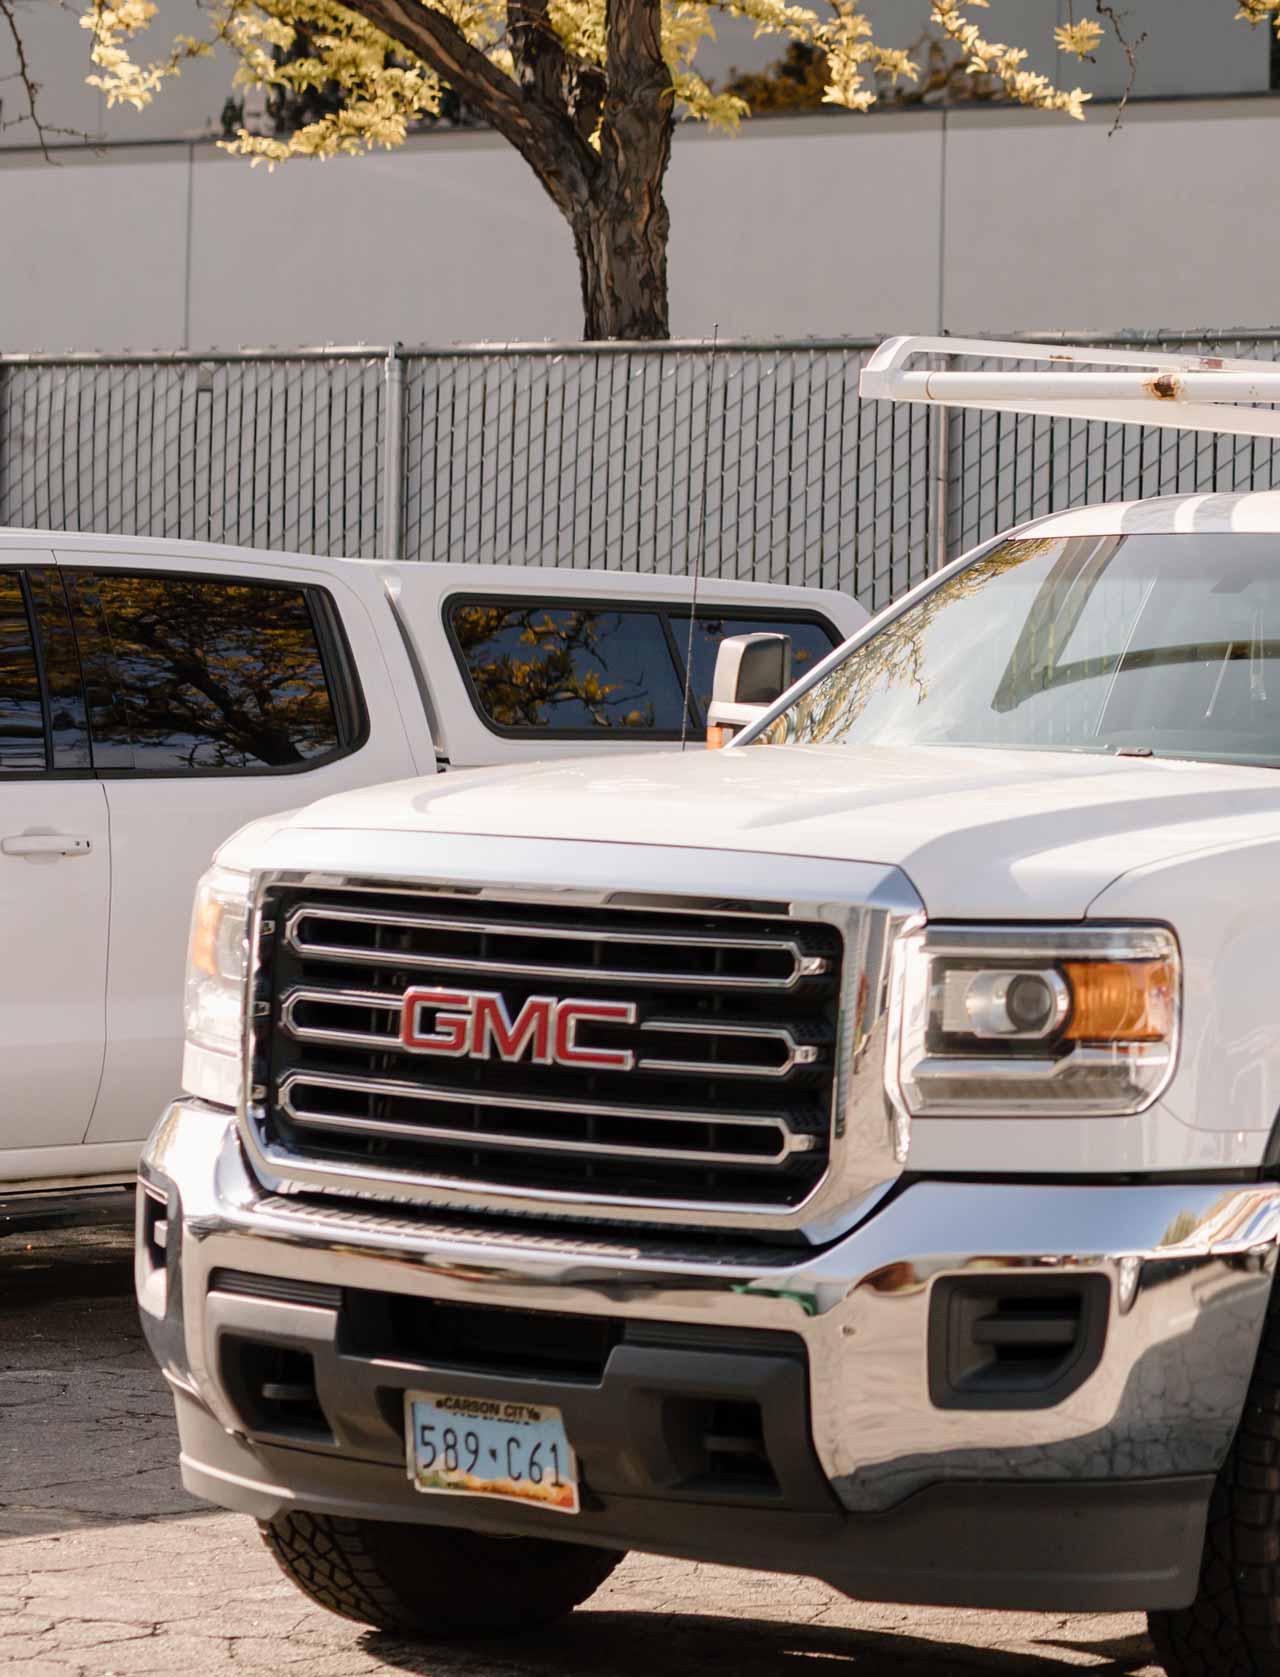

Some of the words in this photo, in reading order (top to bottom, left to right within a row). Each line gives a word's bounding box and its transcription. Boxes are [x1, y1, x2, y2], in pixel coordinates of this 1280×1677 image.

[402, 985, 636, 1071] GMC
[443, 1397, 500, 1415] CARSON
[504, 1405, 534, 1419] CITY
